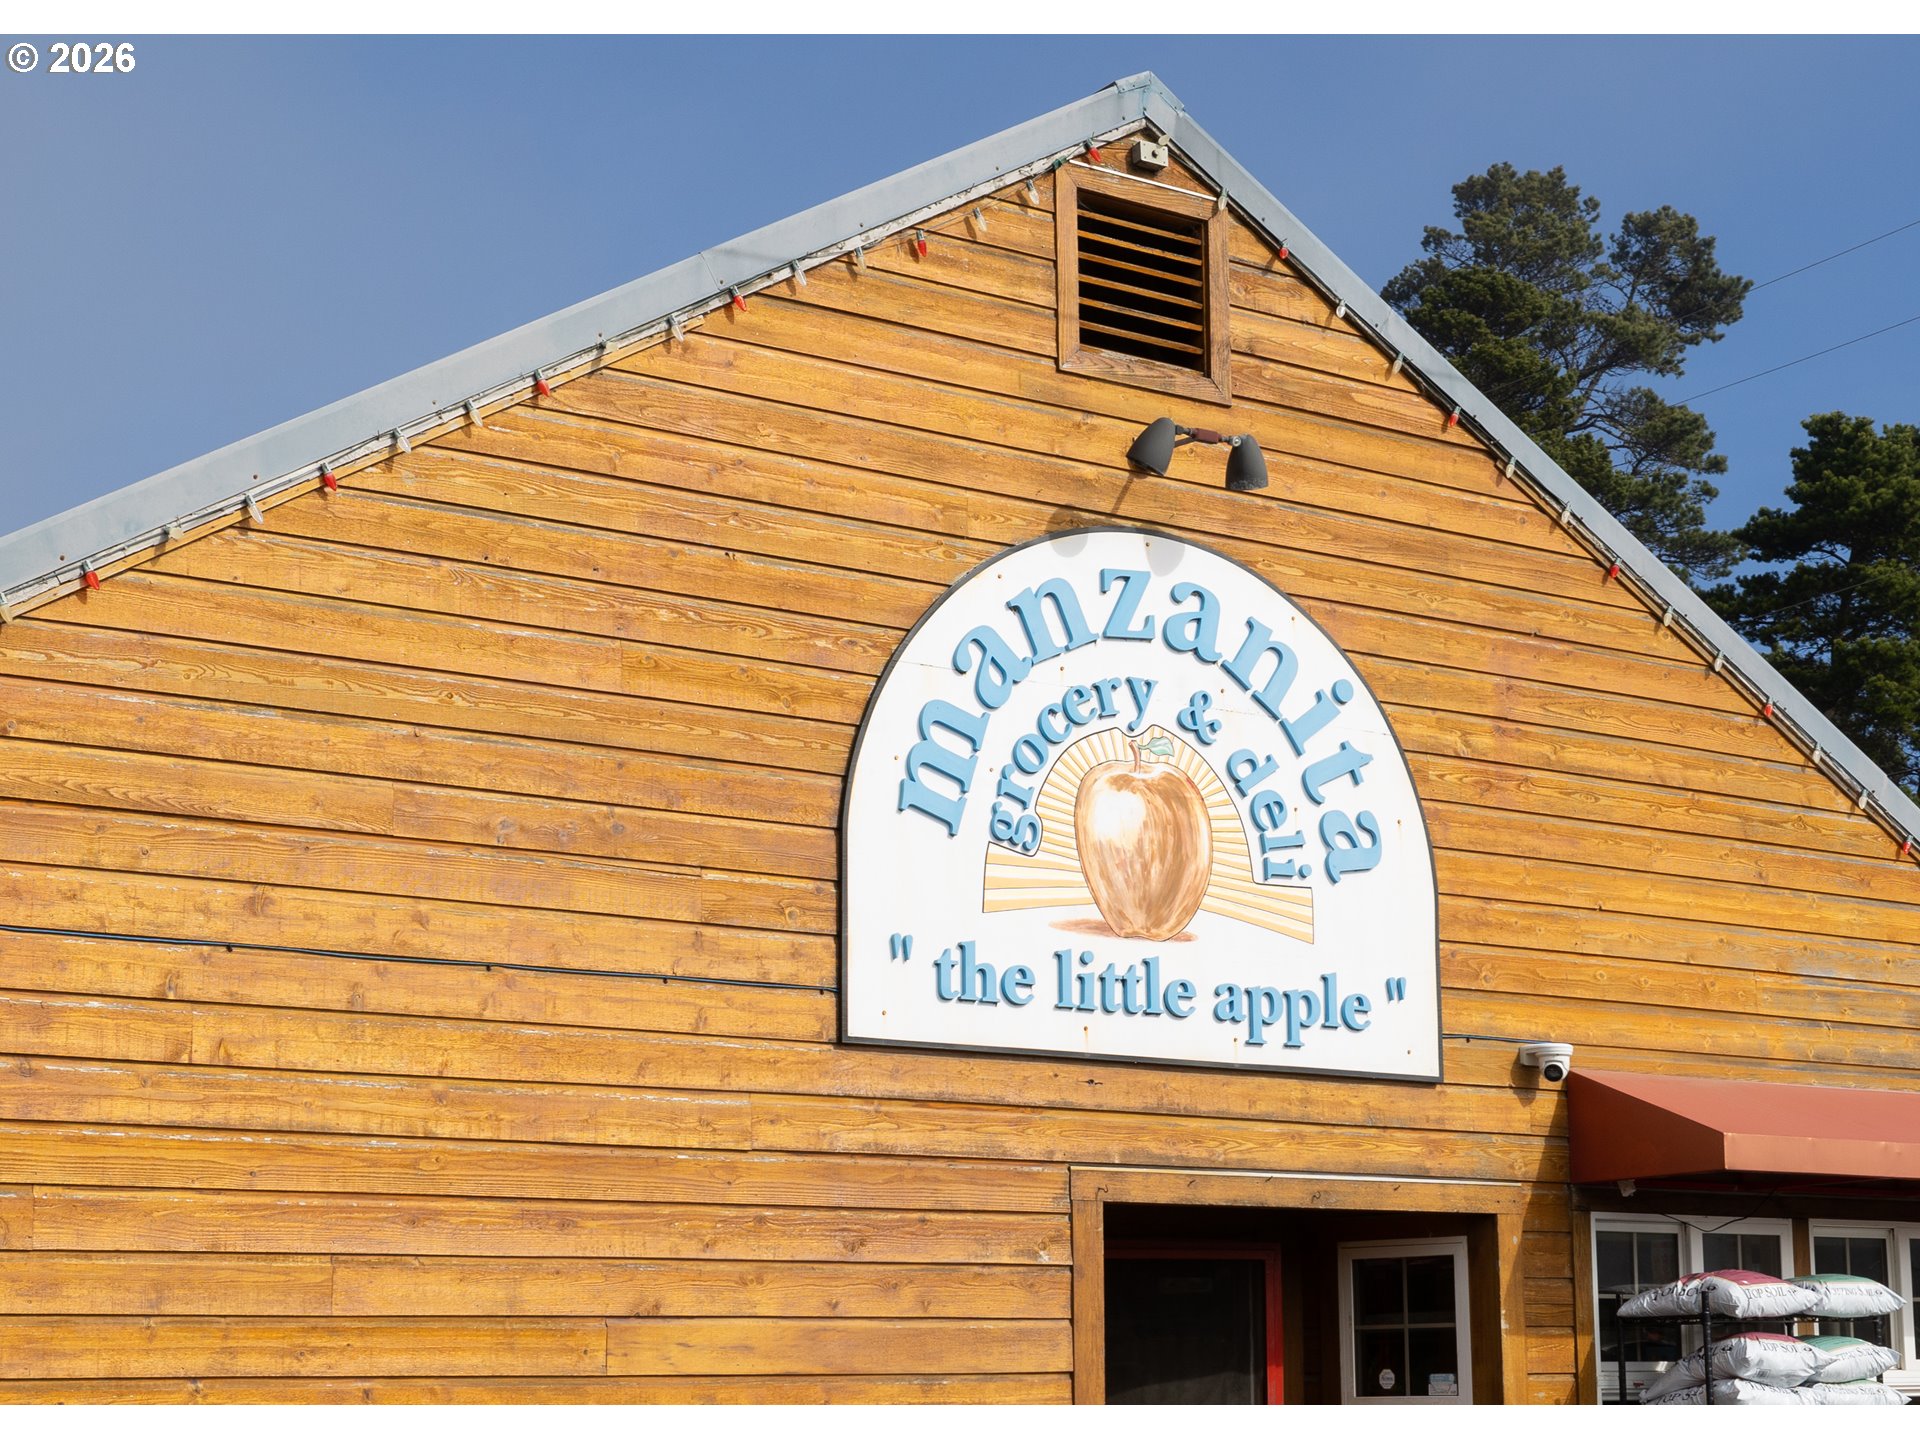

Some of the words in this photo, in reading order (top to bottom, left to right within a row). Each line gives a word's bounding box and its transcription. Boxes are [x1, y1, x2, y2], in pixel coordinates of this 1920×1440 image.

[897, 567, 1384, 886] manzanita
[989, 675, 1159, 854] grocery
[1178, 688, 1224, 744] &
[1226, 748, 1312, 882] deli
[1053, 948, 1197, 1018] little
[1746, 1287, 1765, 1299] TOP
[1766, 1286, 1787, 1299] SOIL
[1762, 1341, 1780, 1352] TOP
